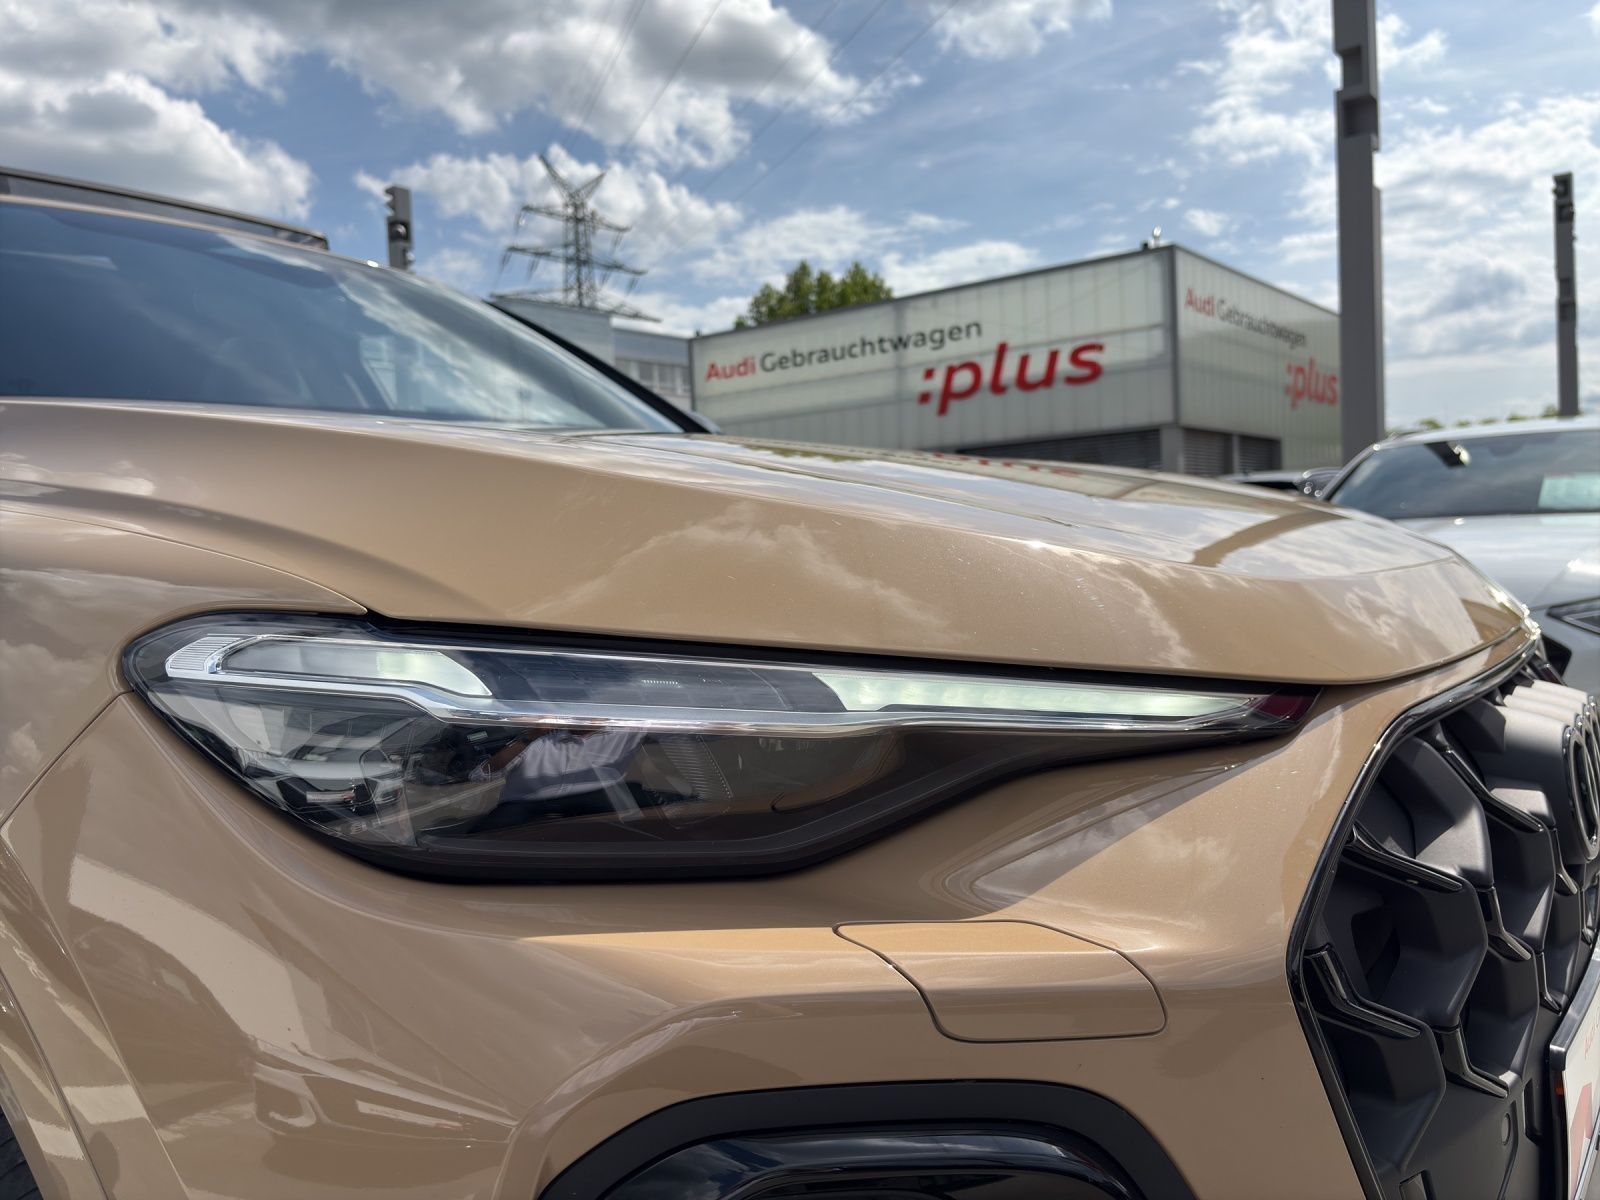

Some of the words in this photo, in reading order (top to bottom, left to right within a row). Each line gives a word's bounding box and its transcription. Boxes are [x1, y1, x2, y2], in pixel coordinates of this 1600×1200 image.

[1184, 287, 1216, 319] Audi
[705, 355, 757, 382] Audi
[759, 321, 983, 373] Gebrauchtwagen
[917, 341, 1105, 417] :plus
